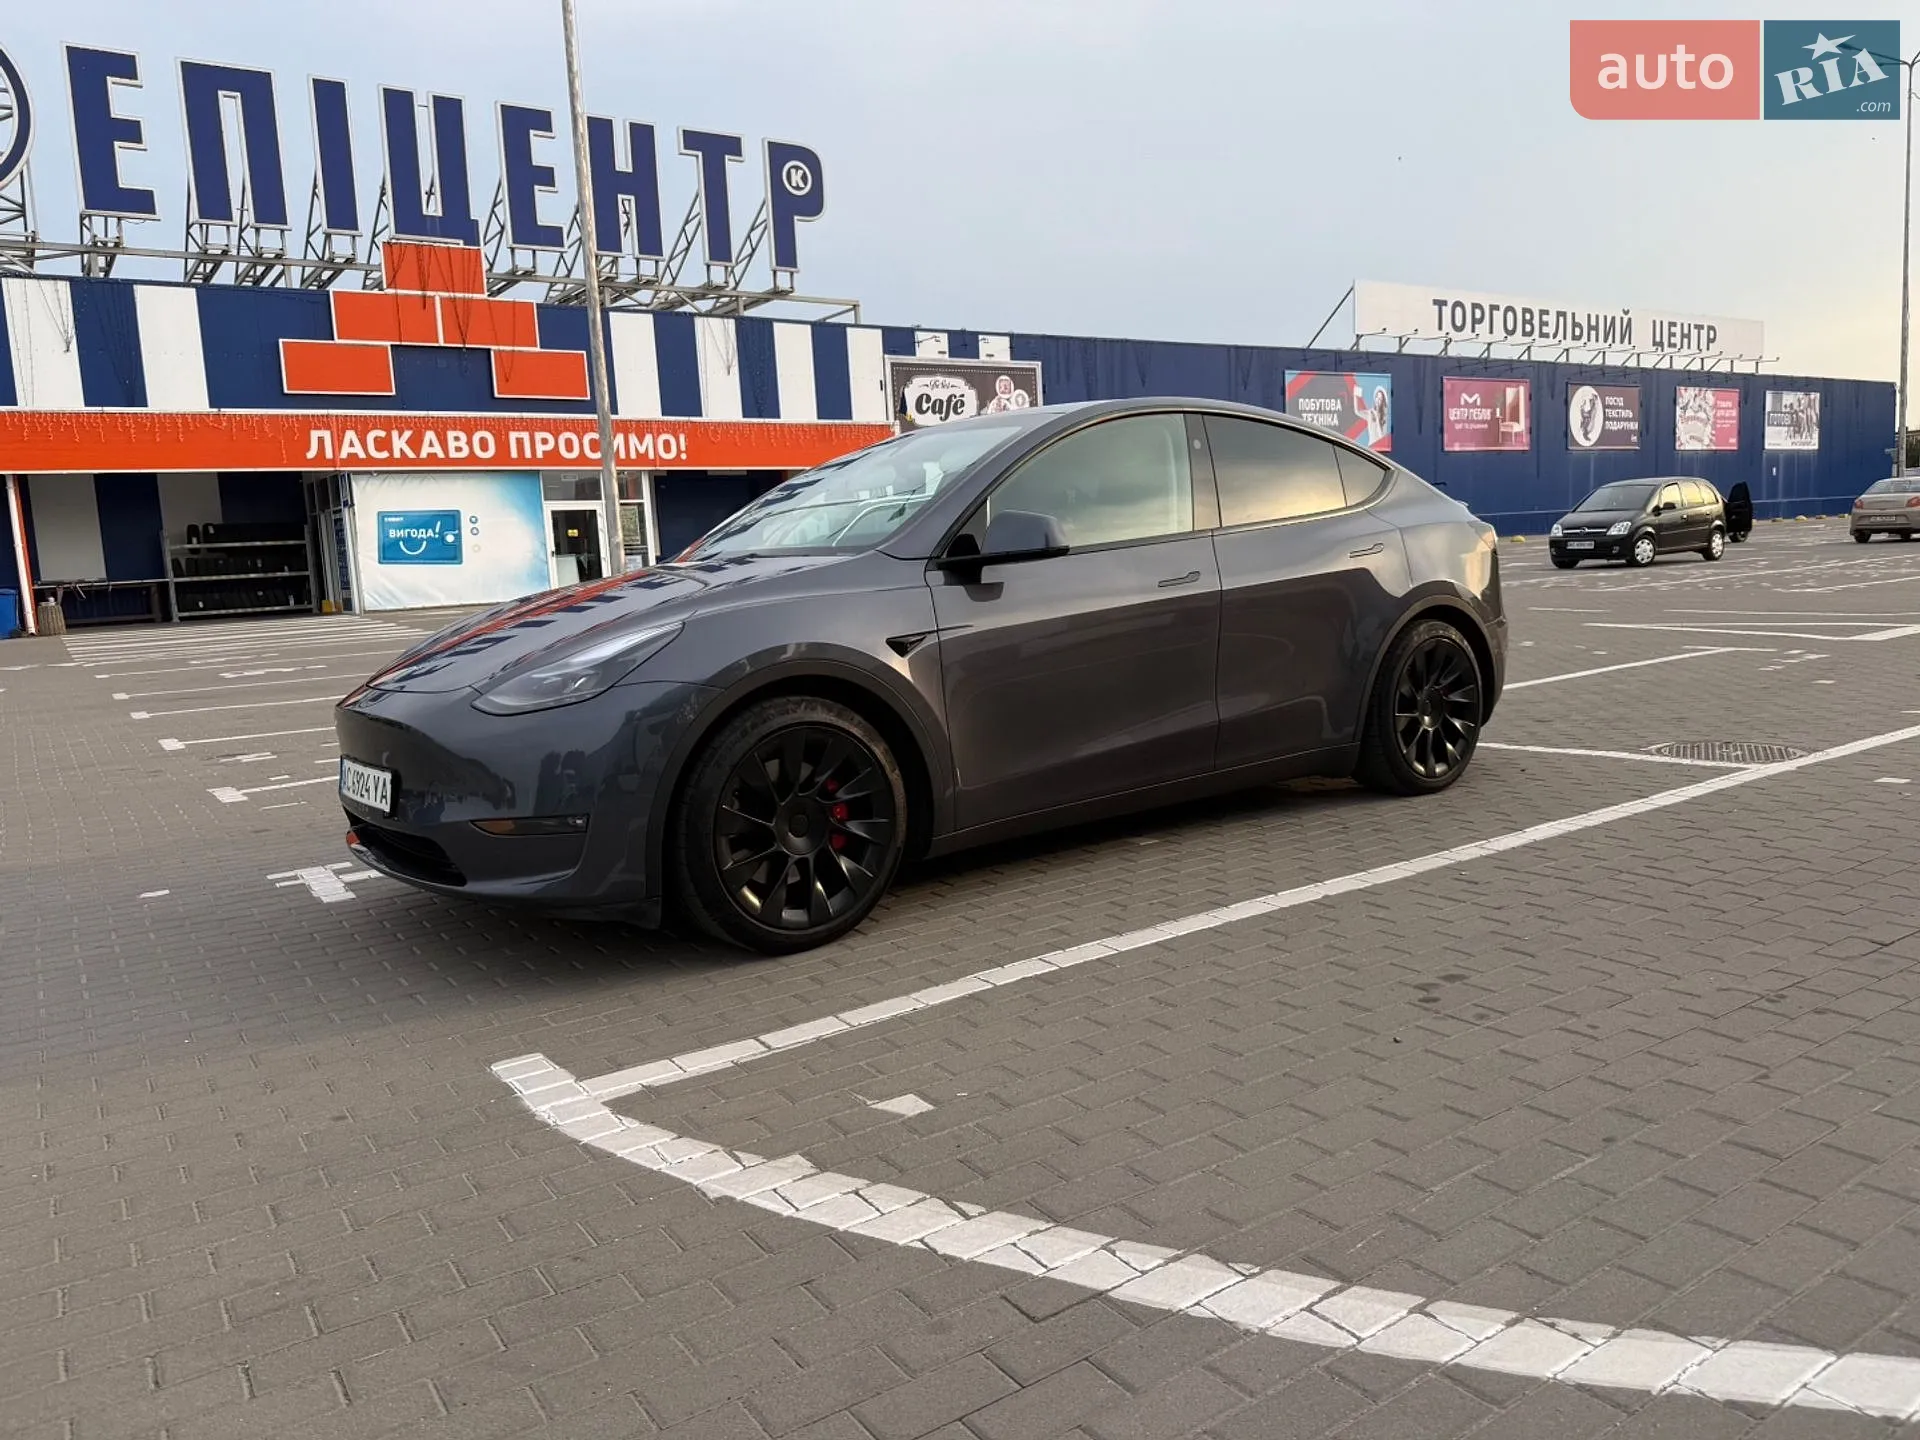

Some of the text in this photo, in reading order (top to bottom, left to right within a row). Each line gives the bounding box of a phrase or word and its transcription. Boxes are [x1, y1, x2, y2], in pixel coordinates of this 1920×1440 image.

[60, 41, 826, 272] ЕПІЦЕНТР
[1433, 299, 1718, 352] ТОРГОВЕЛЬНИЙ ЦЕНТР
[915, 393, 965, 422] Café
[1299, 398, 1342, 412] ПОБУТОВА
[1301, 413, 1339, 427] ТЕХНІКА
[305, 429, 496, 460] ЛАСКАВО
[389, 520, 441, 539] ВИГОДА!
